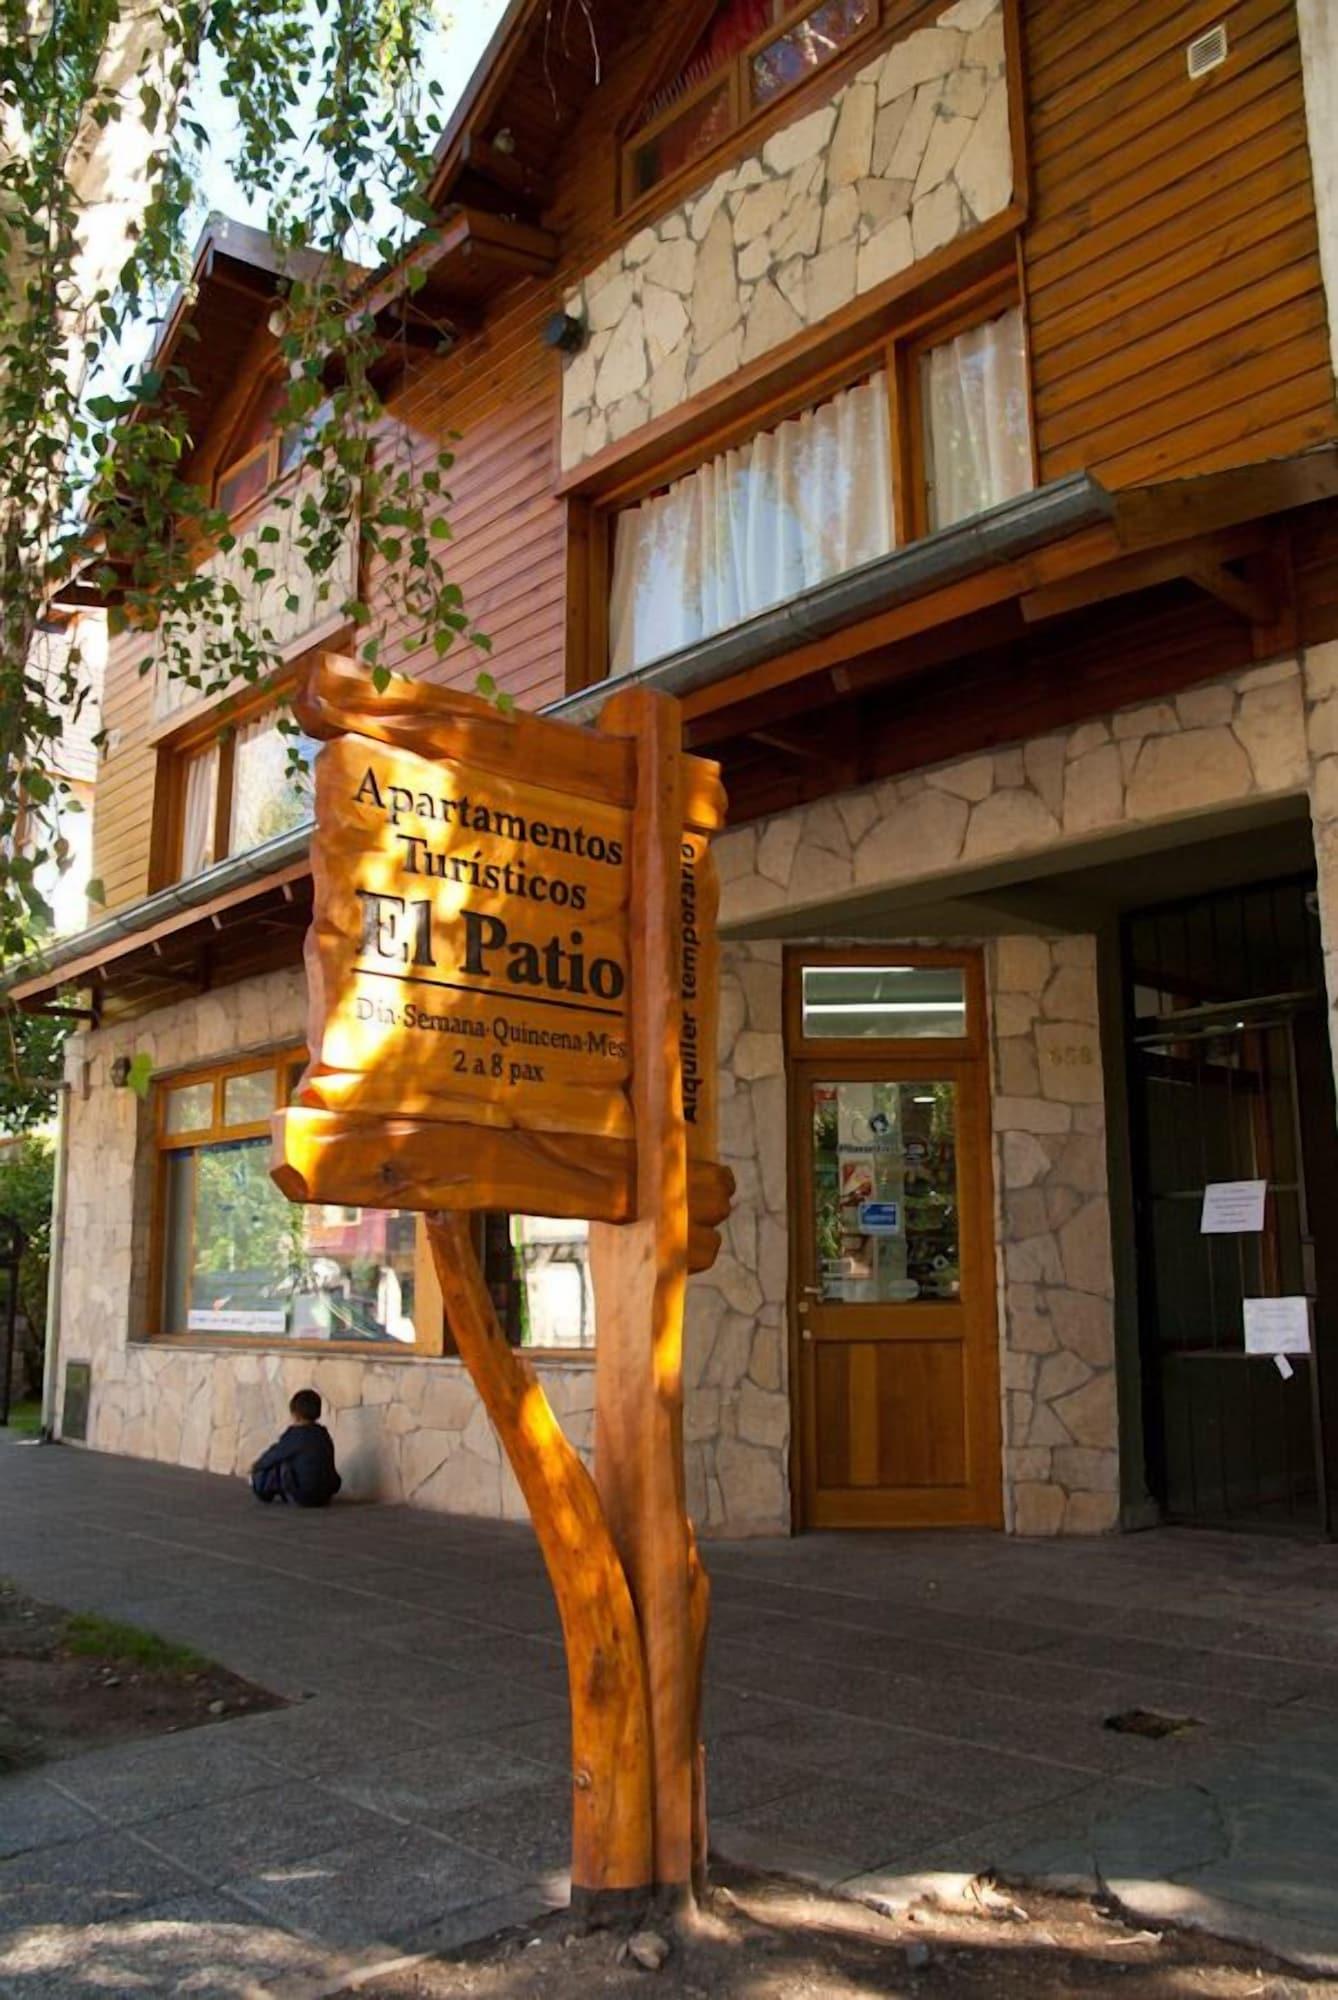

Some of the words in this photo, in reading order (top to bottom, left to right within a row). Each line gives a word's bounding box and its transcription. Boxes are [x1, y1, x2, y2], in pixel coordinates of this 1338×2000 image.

[353, 767, 623, 865] Apartamentos
[396, 833, 587, 910] Turísticos
[680, 843, 701, 1001] temporario
[354, 888, 436, 967] El
[459, 908, 624, 1000] Patio
[453, 1050, 468, 1073] 2
[472, 1056, 486, 1076] a
[491, 1052, 503, 1078] 8
[509, 1061, 545, 1085] pax
[679, 1010, 704, 1124] Alquiler
